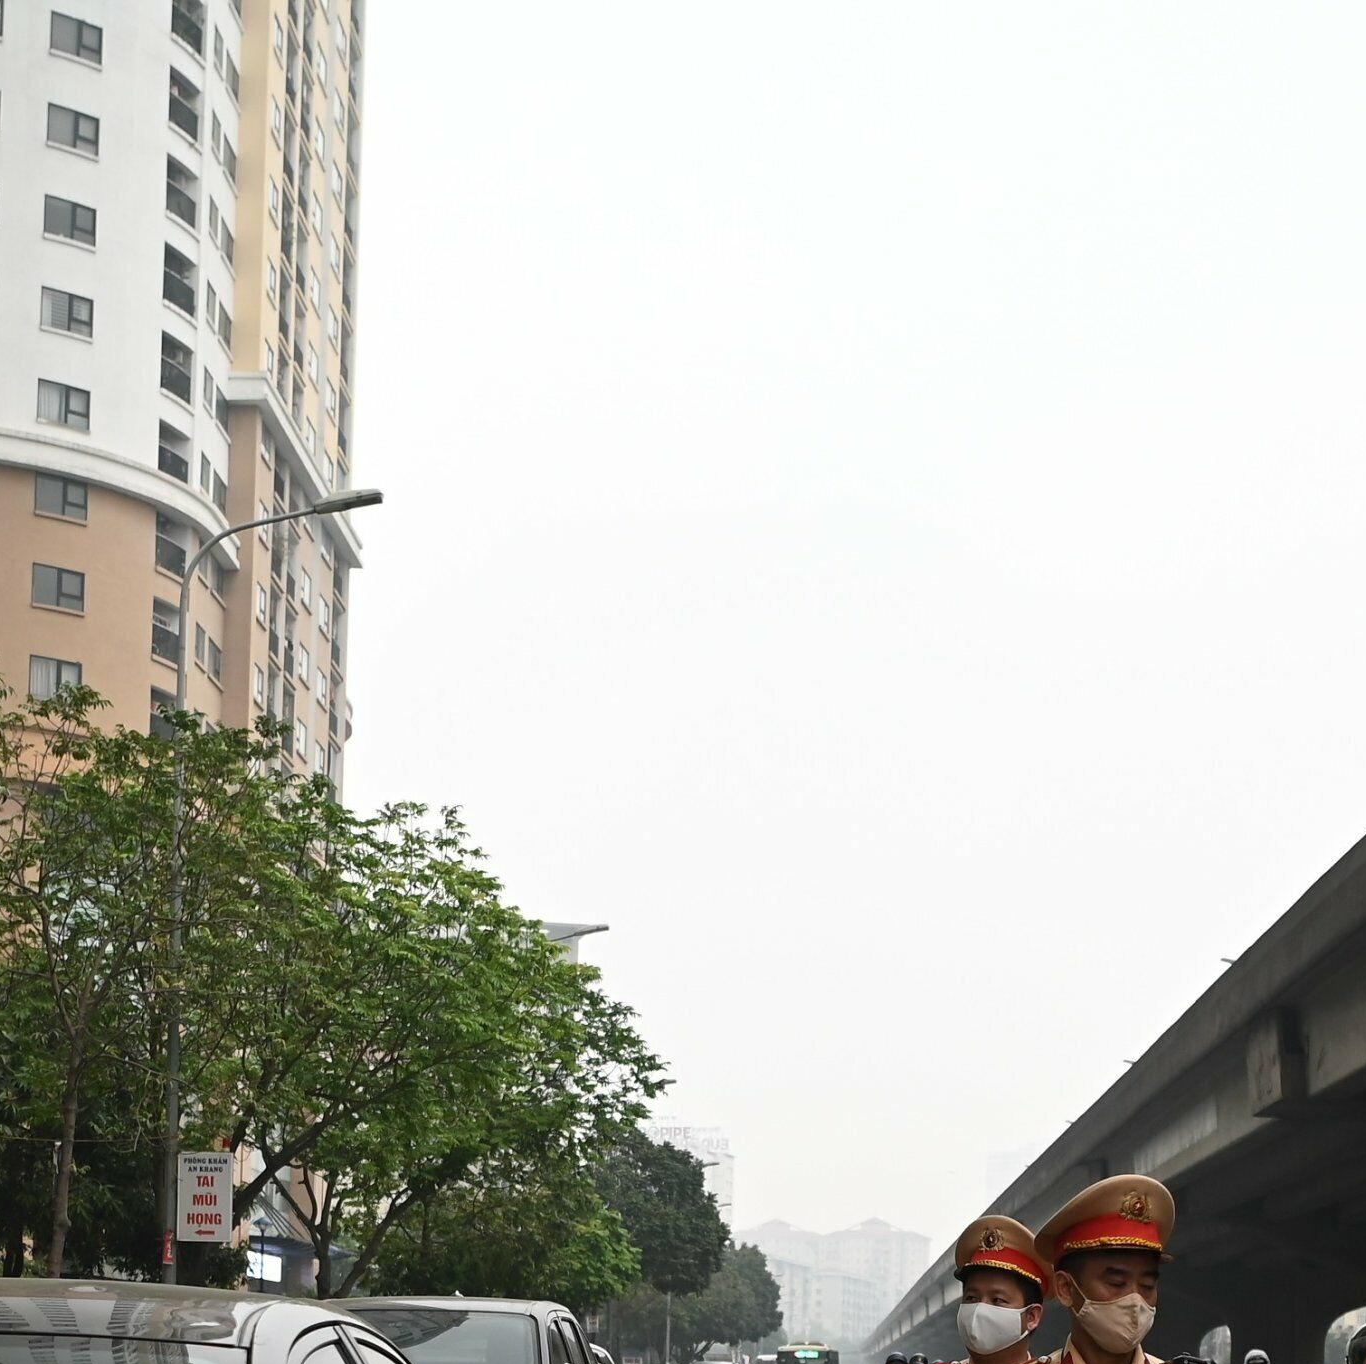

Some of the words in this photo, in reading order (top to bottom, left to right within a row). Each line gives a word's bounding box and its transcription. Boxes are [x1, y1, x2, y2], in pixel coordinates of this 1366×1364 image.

[184, 1156, 206, 1164] PHÒNG
[208, 1156, 228, 1165] KHÁM
[196, 1175, 214, 1187] TAI
[192, 1192, 217, 1206] MŨI
[187, 1212, 222, 1228] HỌNG
